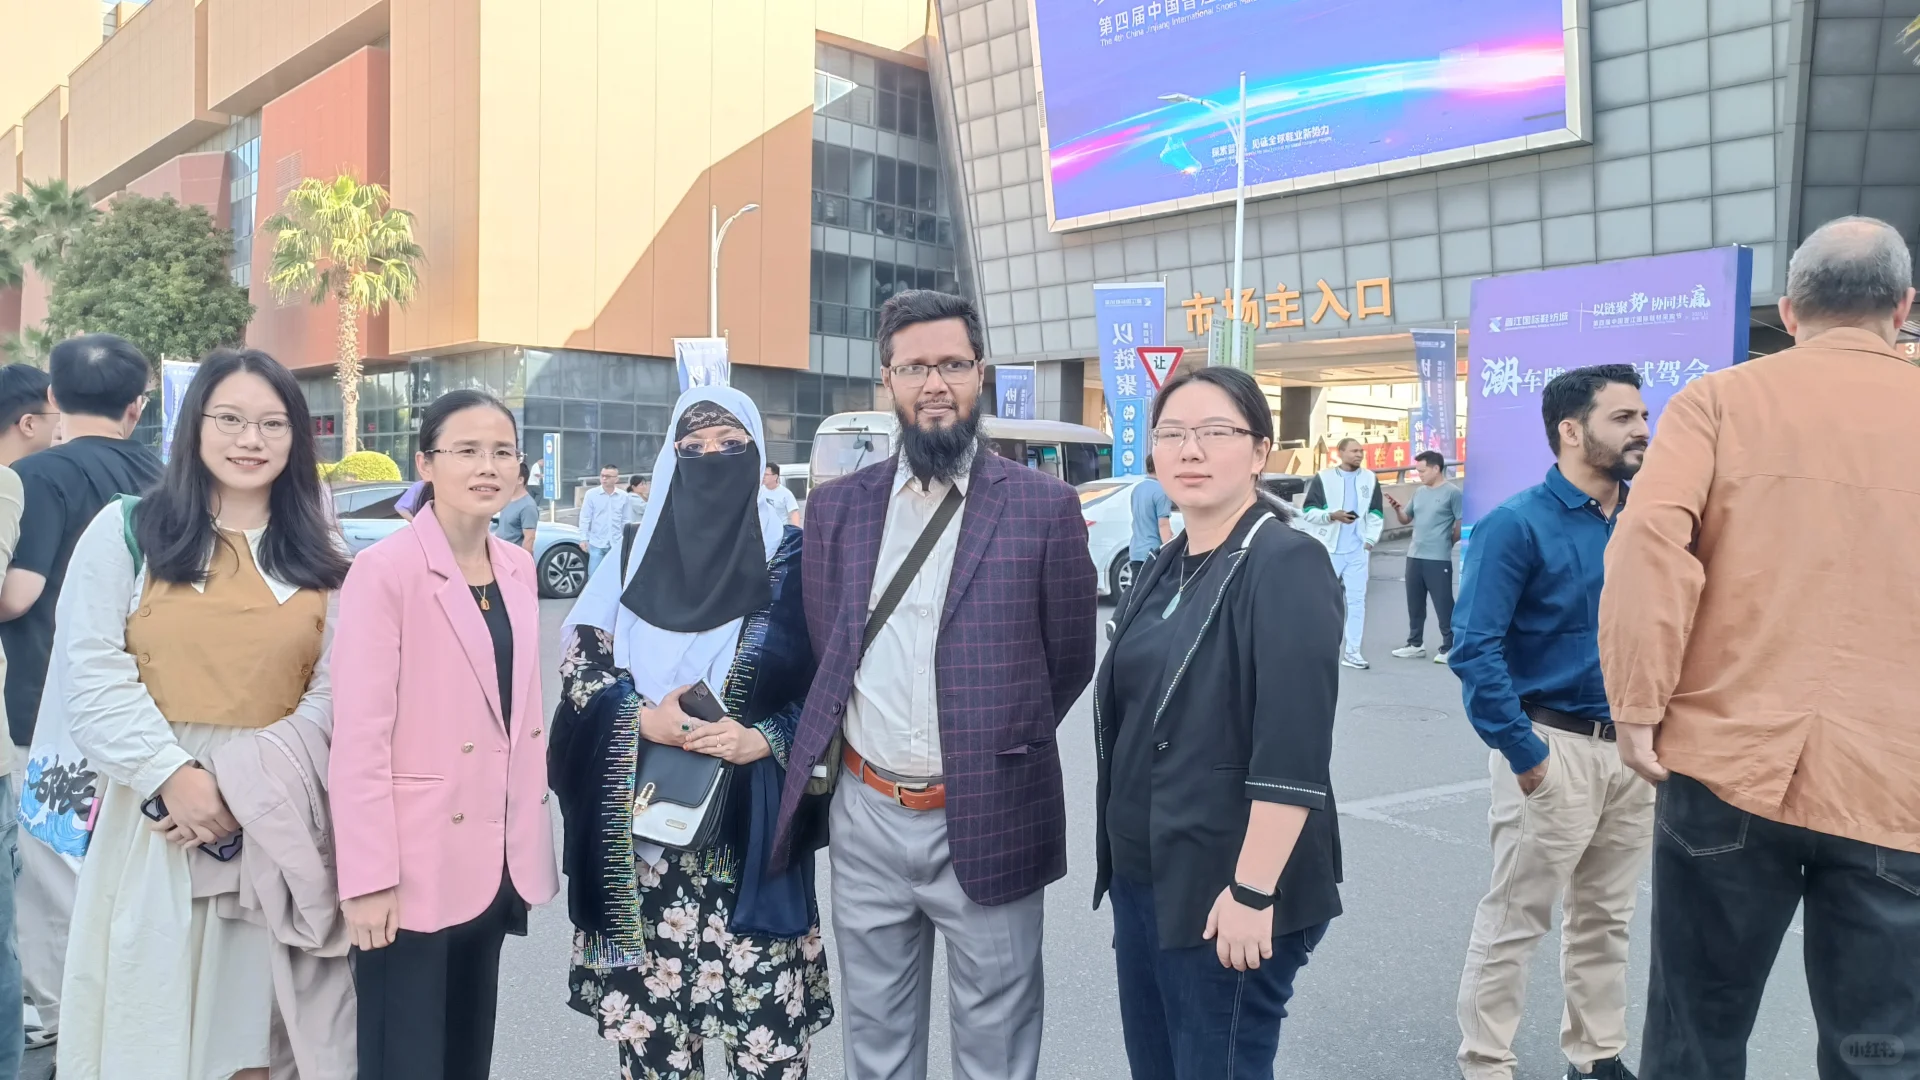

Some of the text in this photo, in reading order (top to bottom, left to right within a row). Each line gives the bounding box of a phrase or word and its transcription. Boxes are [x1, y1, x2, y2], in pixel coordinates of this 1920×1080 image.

[1100, 38, 1112, 47] The
[1126, 28, 1144, 39] China
[1172, 6, 1214, 26] International
[1181, 277, 1392, 336] 市场主入口
[1154, 355, 1167, 370] 让
